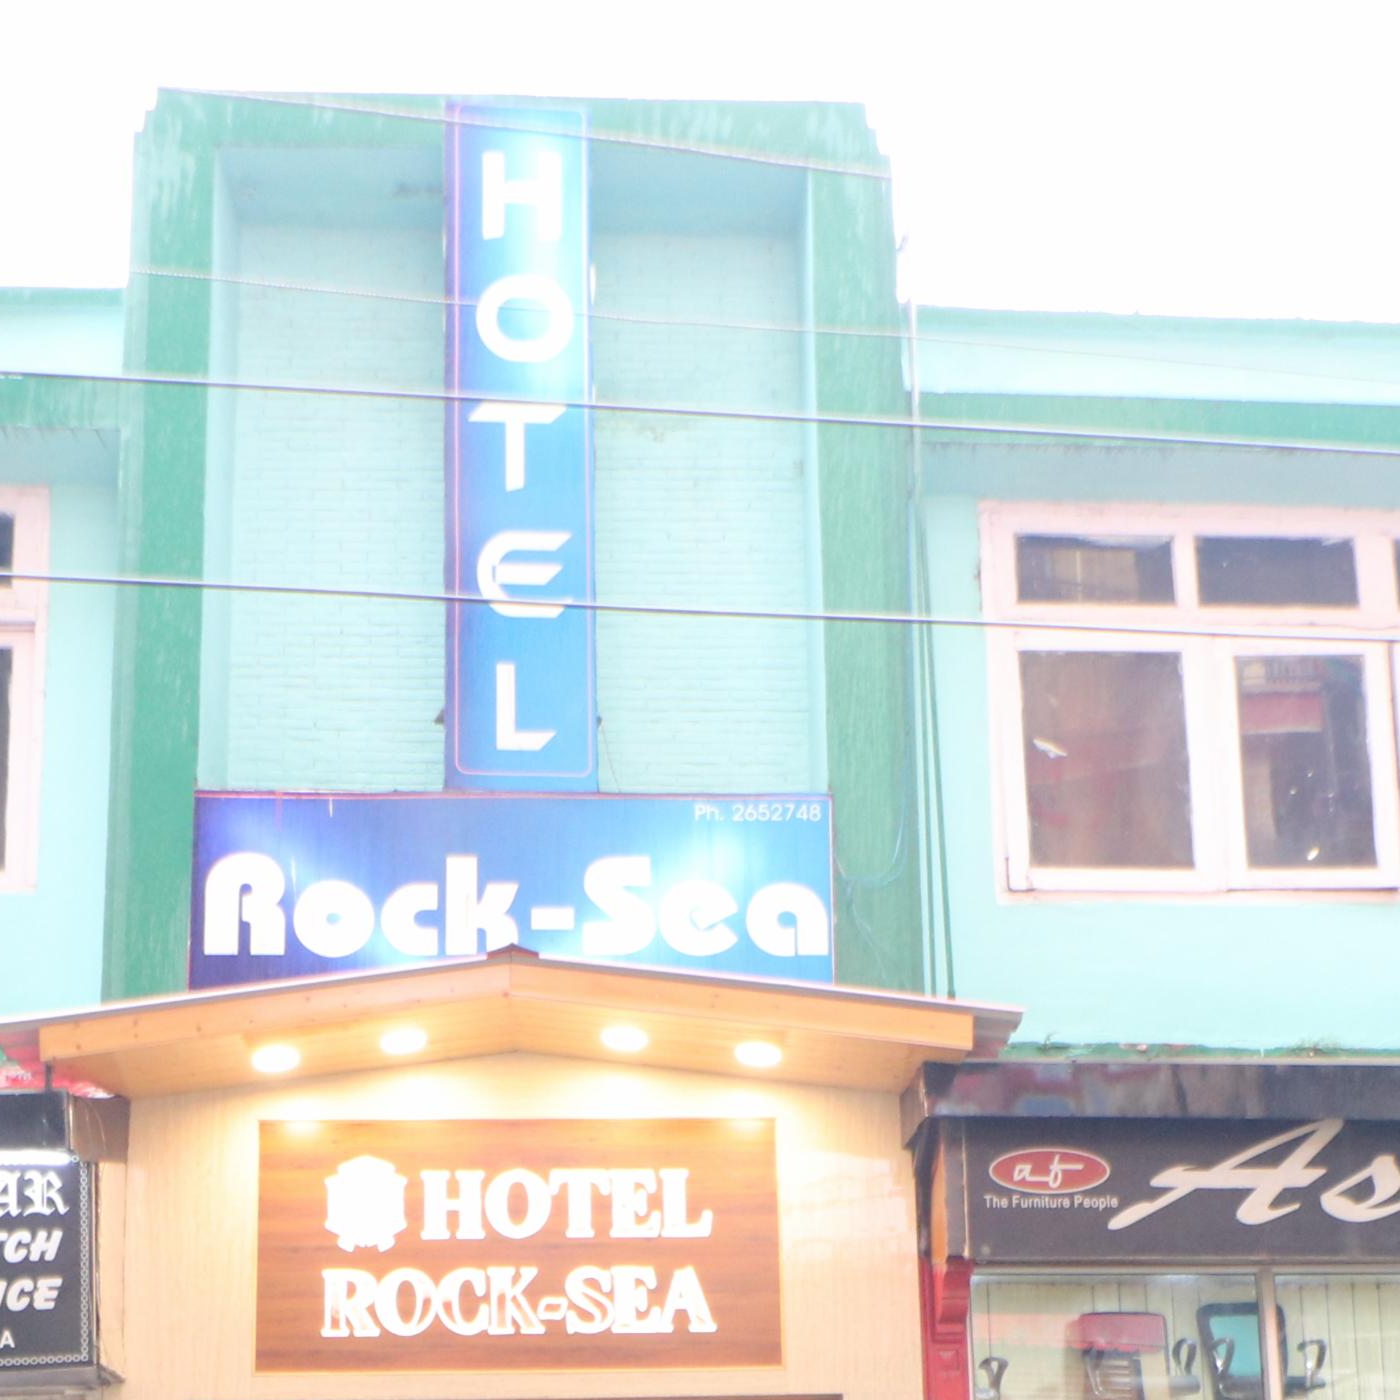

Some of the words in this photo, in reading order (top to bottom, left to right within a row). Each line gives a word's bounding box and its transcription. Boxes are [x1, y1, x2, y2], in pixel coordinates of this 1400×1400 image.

[468, 151, 575, 751] HOTEL
[731, 803, 822, 823] 2652748
[203, 852, 830, 957] Rock-Sea
[419, 1167, 714, 1241] HOTEL
[984, 1194, 1009, 1209] The
[1012, 1194, 1071, 1209] Furniture
[1073, 1194, 1119, 1212] People
[320, 1264, 719, 1339] ROCK-SEA
